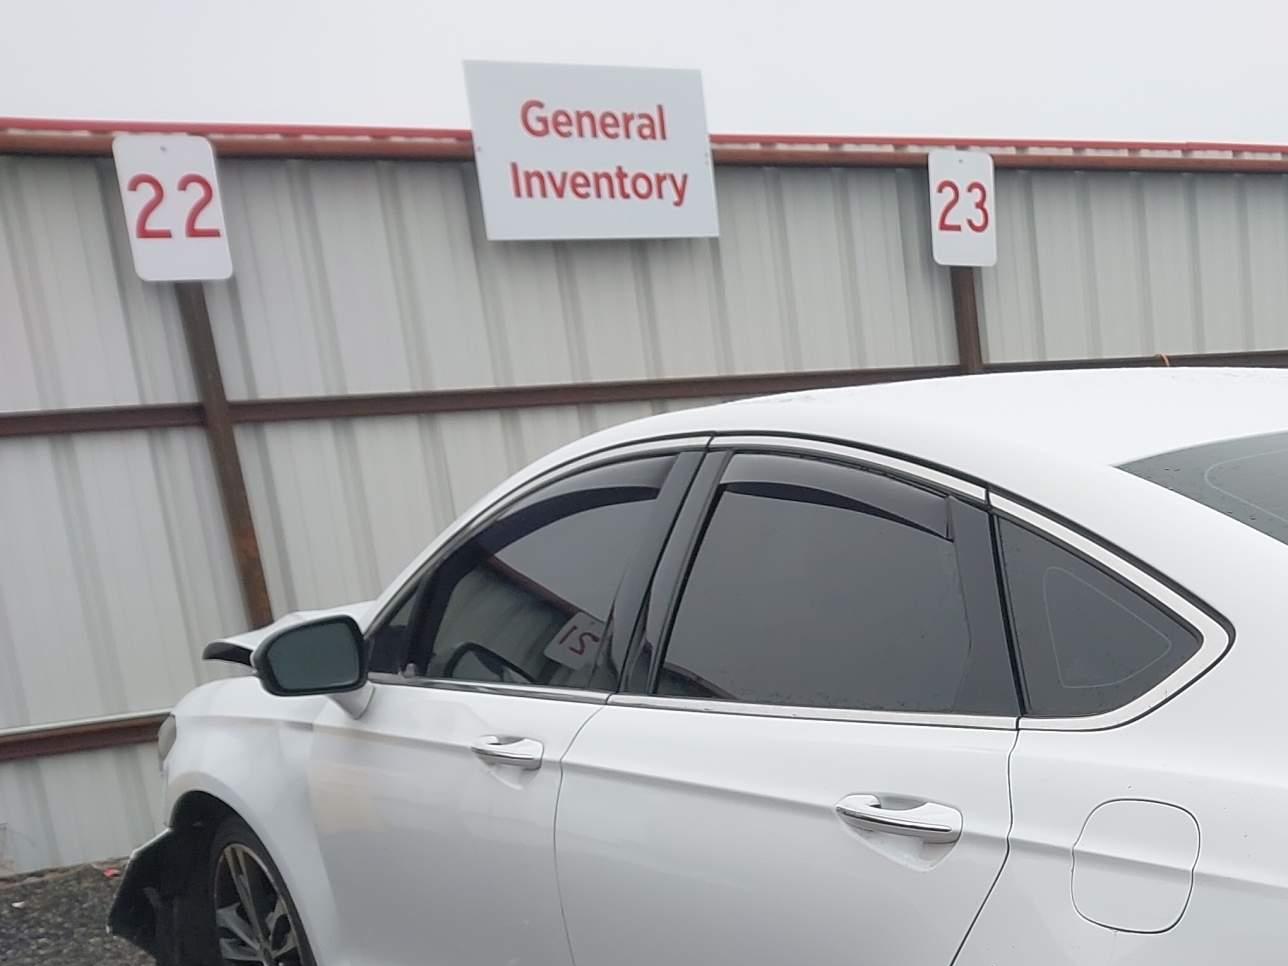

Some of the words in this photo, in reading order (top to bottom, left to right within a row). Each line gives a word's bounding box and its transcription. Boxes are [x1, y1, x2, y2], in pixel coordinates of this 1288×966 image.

[520, 99, 669, 140] General
[126, 173, 222, 240] 22
[511, 163, 689, 206] Inventory
[937, 179, 991, 233] 23
